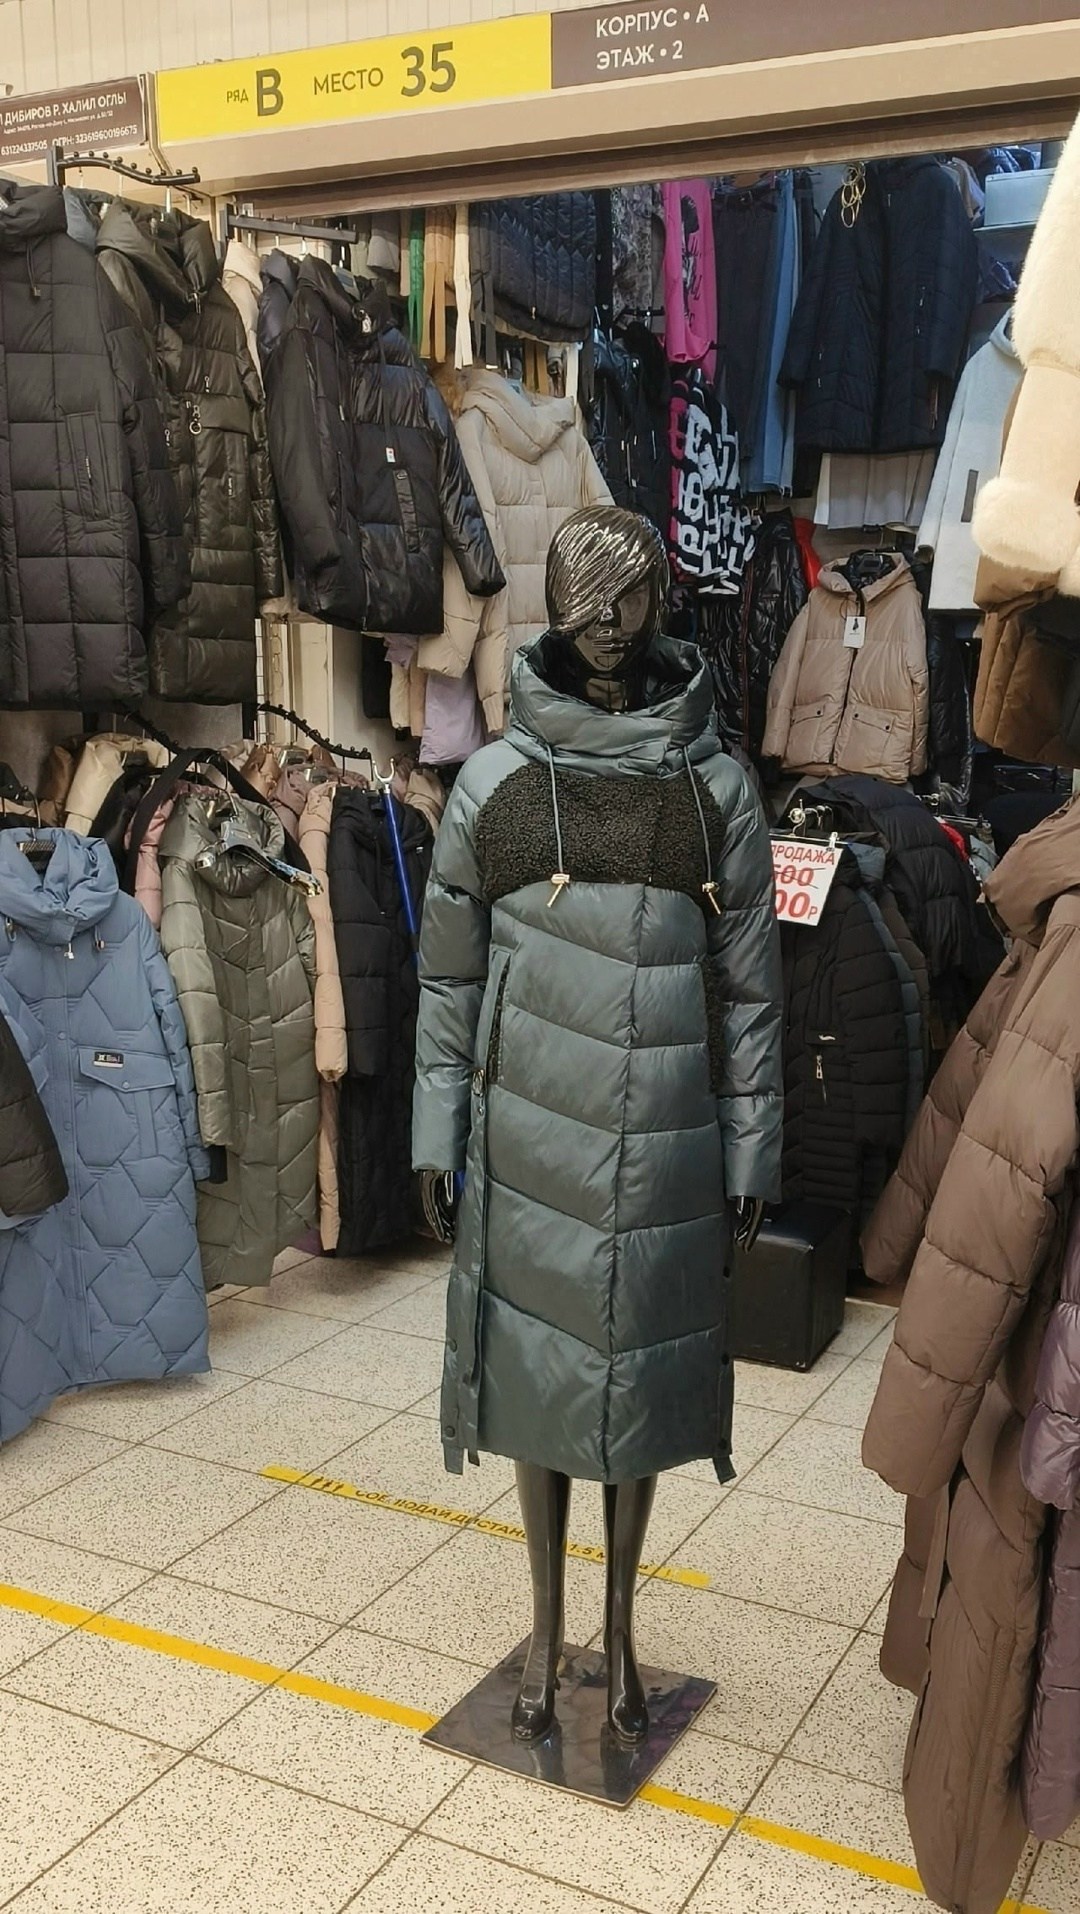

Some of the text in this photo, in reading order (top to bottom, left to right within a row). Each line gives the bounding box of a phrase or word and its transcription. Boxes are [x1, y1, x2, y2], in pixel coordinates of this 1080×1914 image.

[596, 3, 710, 38] КОРПУС А
[596, 40, 683, 70] ЭТАЖ 2
[226, 41, 456, 117] РЯД В МЕСТО 35
[4, 106, 51, 126] ДИБИРОВ
[53, 104, 61, 117] Р.
[62, 98, 96, 113] ХАЛИЛ
[97, 91, 127, 108] ОГЛЫ
[1, 140, 48, 156] 631224337505
[450, 1514, 527, 1539] ДИСТАН
